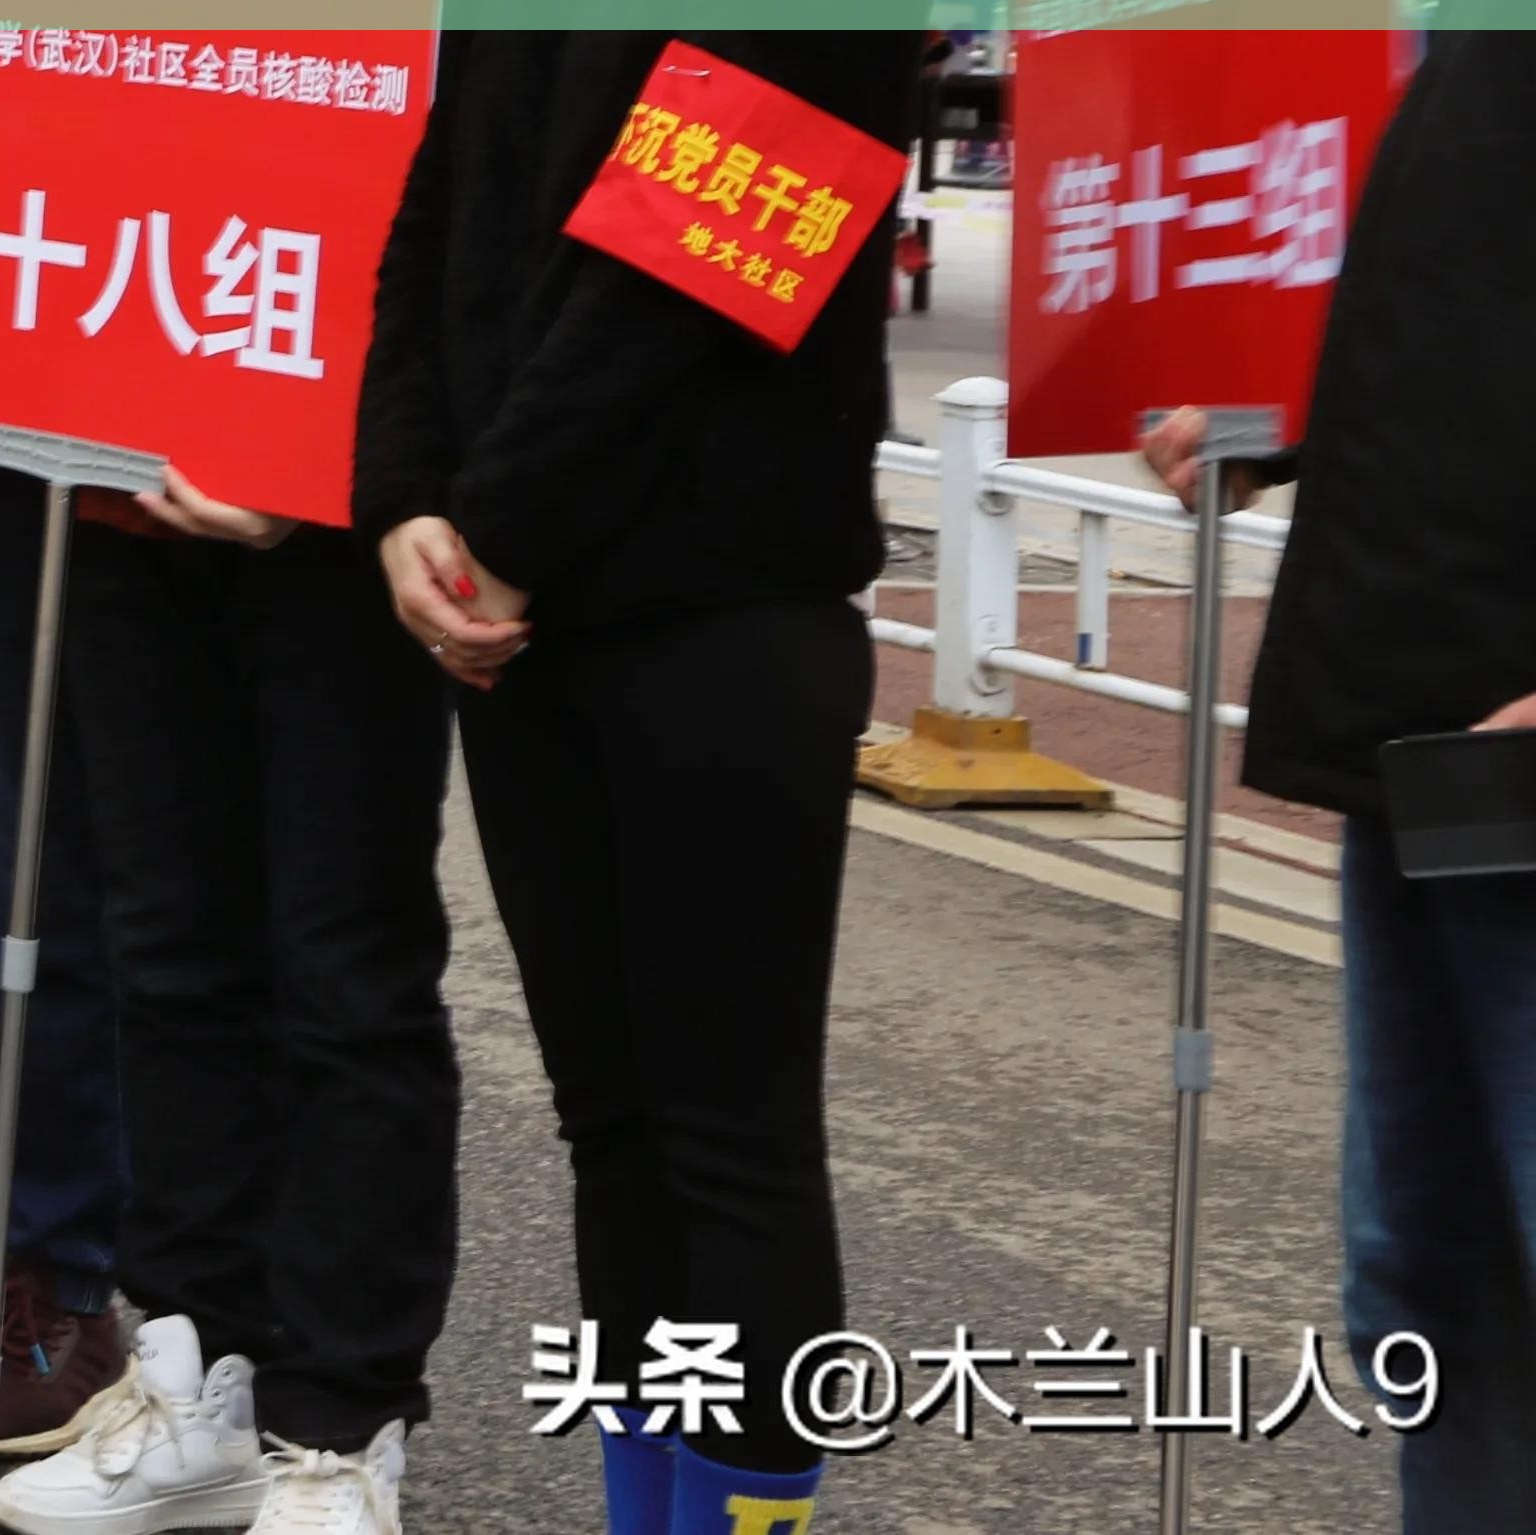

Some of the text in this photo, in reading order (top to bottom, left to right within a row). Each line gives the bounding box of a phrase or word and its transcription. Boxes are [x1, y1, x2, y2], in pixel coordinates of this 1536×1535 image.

[678, 220, 805, 304] 地大社区
[1039, 116, 1348, 314] 第十三组
